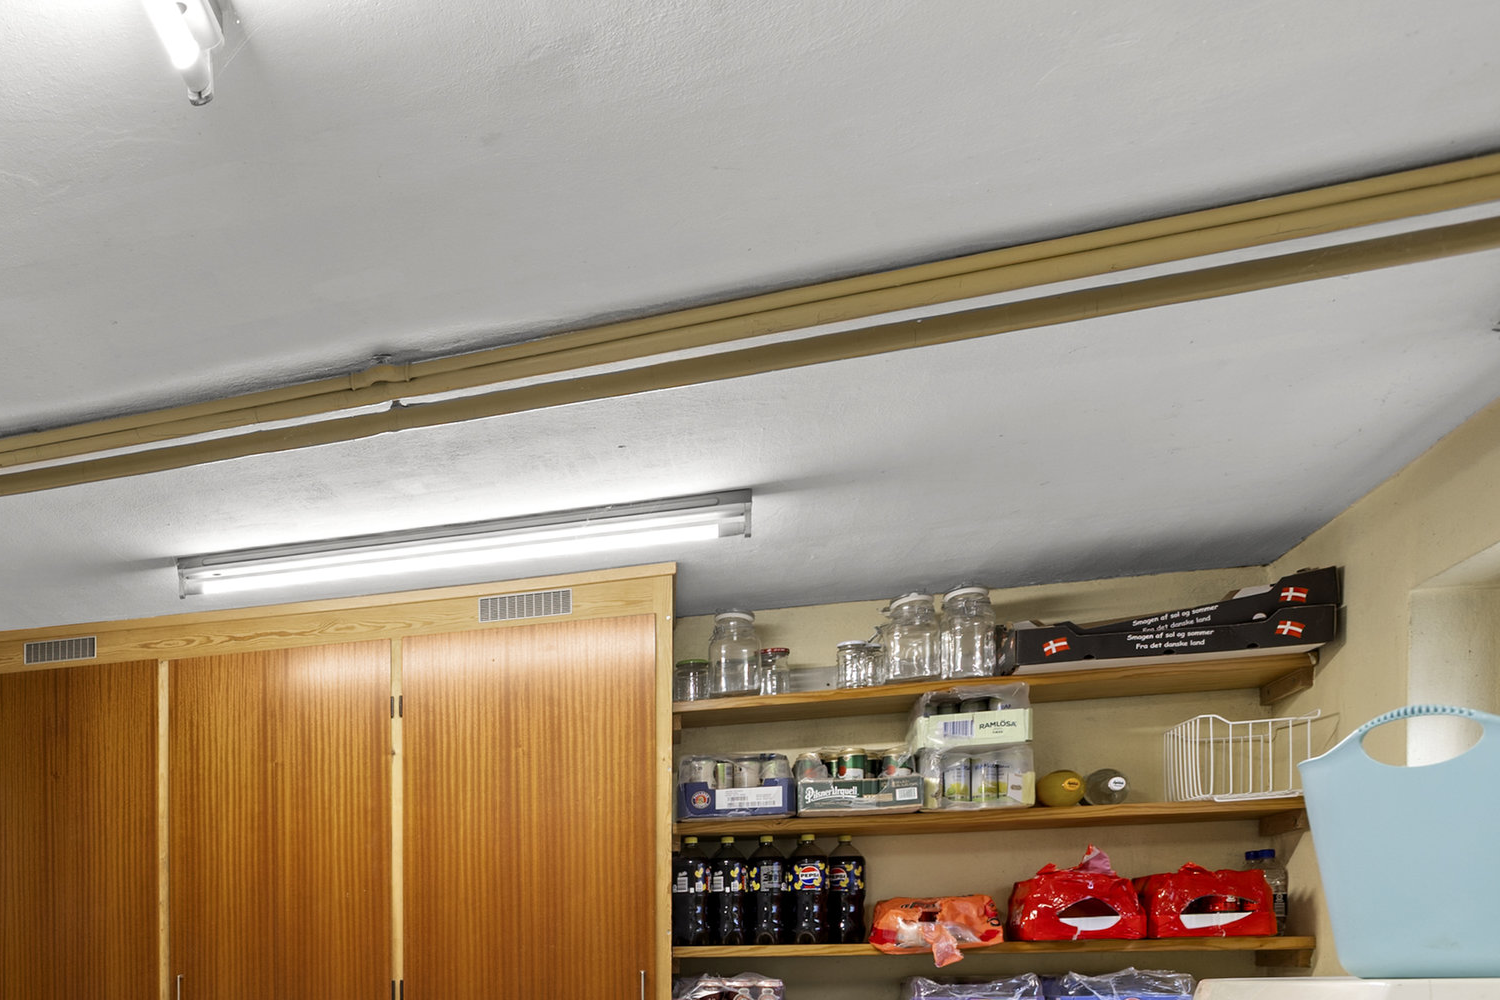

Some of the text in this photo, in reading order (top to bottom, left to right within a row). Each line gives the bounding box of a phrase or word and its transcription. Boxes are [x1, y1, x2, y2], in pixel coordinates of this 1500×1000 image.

[1132, 617, 1159, 627] Smagen
[1170, 611, 1180, 619] sol
[1191, 604, 1219, 614] sommer
[1170, 619, 1194, 629] danske
[1196, 615, 1211, 623] land
[1187, 629, 1215, 637] sommer
[979, 720, 1017, 729] RAMLÖSA
[805, 785, 859, 804] Pilsner Urquell
